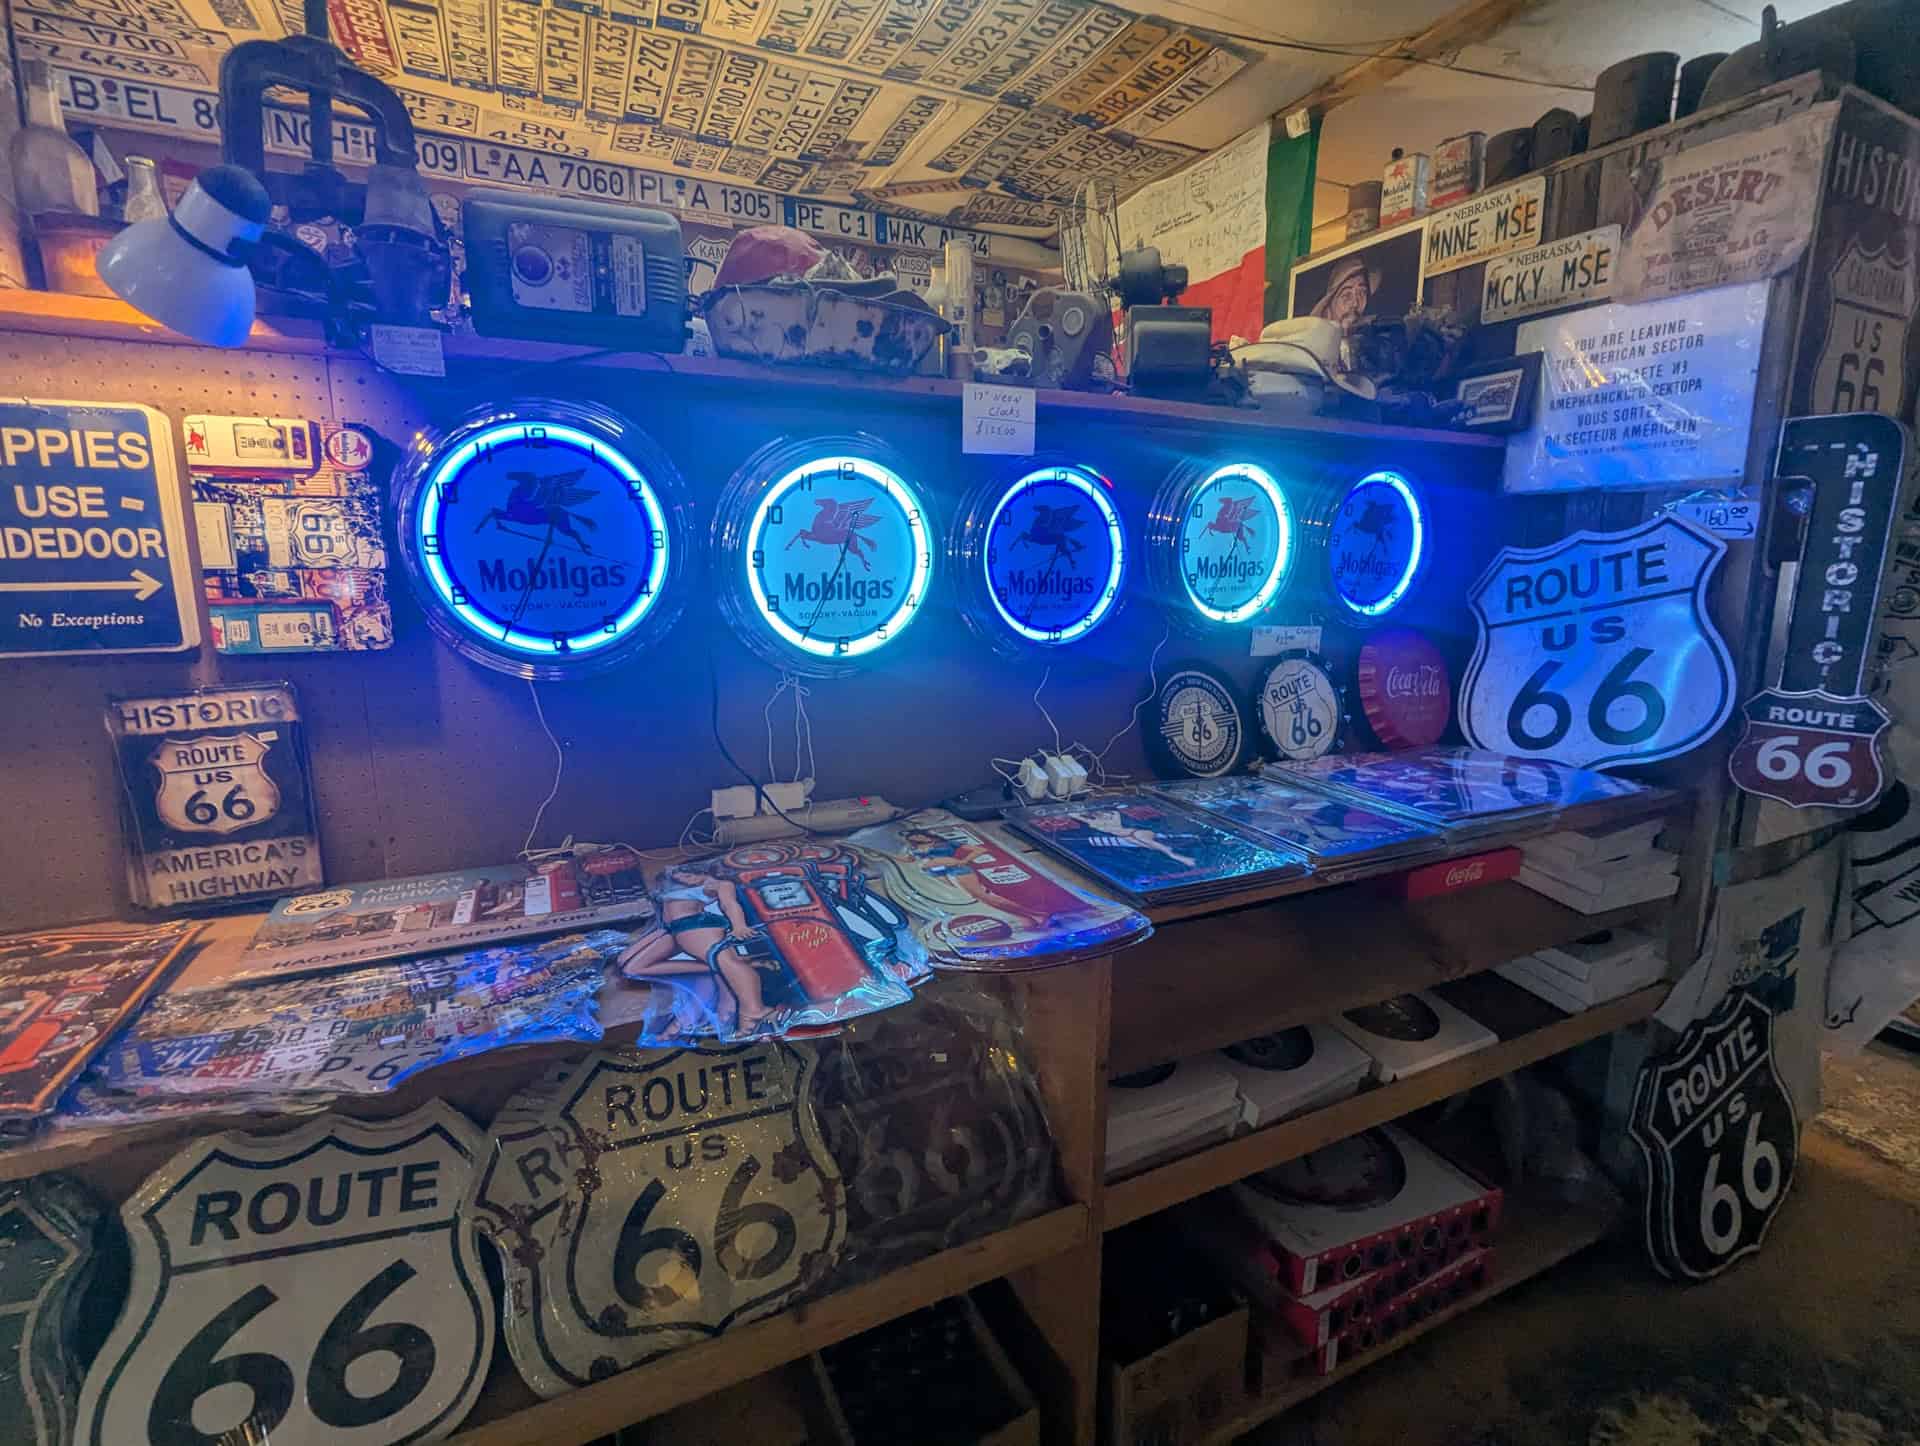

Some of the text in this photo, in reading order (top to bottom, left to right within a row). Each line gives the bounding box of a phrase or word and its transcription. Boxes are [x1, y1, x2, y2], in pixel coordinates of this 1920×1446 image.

[596, 22, 629, 57] 333
[632, 36, 673, 96] 17-276
[1143, 74, 1212, 123] HEYN
[487, 129, 591, 158] 45303
[520, 122, 567, 141] BN
[560, 162, 625, 198] 7060
[720, 187, 771, 219] 1305
[797, 204, 825, 231] PE
[1453, 192, 1513, 221] NEBRASKA
[1650, 169, 1784, 232] DESERT
[888, 218, 927, 248] WAK
[1428, 197, 1539, 264] MNNE MSE
[700, 241, 728, 259] KAN
[1515, 238, 1583, 268] NEBRASKA
[911, 276, 931, 288] US
[1485, 263, 1546, 312] MCKY
[1560, 248, 1612, 293] MSE
[1601, 331, 1625, 346] ARE
[1631, 318, 1687, 342] LEAVING
[1651, 333, 1705, 355] SECTOR
[1852, 319, 1884, 354] US
[1565, 427, 1618, 447] SECTEUR
[1576, 410, 1609, 429] VOUS
[0, 428, 150, 469] PPIES
[15, 485, 109, 519] USE
[0, 527, 167, 560] DEDOOR
[302, 513, 335, 553] 66
[1196, 555, 1265, 584] Mobilgas
[1811, 452, 1880, 665] HISTORIC
[477, 557, 627, 597] Mobilgas
[784, 572, 894, 607] Mobilgas
[1008, 570, 1095, 602] Mobilgas
[1504, 542, 1670, 615] ROUTE
[19, 611, 145, 630] No Exceptions
[1541, 615, 1626, 651] US
[1271, 673, 1313, 704] ROUTE
[1506, 647, 1667, 751] 66
[119, 695, 286, 731] HISTORIC
[1291, 709, 1323, 746] 66
[1768, 705, 1857, 729] ROUTE
[1192, 722, 1213, 742] 66
[175, 744, 246, 767] ROUTE
[1756, 735, 1852, 789] 66
[193, 770, 233, 785] US
[184, 783, 255, 825] 66
[151, 839, 308, 875] AMERICA'S
[168, 866, 300, 901] HIGHWAY
[294, 900, 339, 912] 66
[1666, 1015, 1761, 1127] ROUTE
[604, 1055, 769, 1131] ROUTE
[1702, 1091, 1747, 1150] US
[665, 1132, 728, 1171] US
[1700, 1110, 1781, 1256] 66
[190, 1160, 441, 1247] ROUTE
[612, 1155, 798, 1312] 66
[147, 1258, 437, 1446] 66
